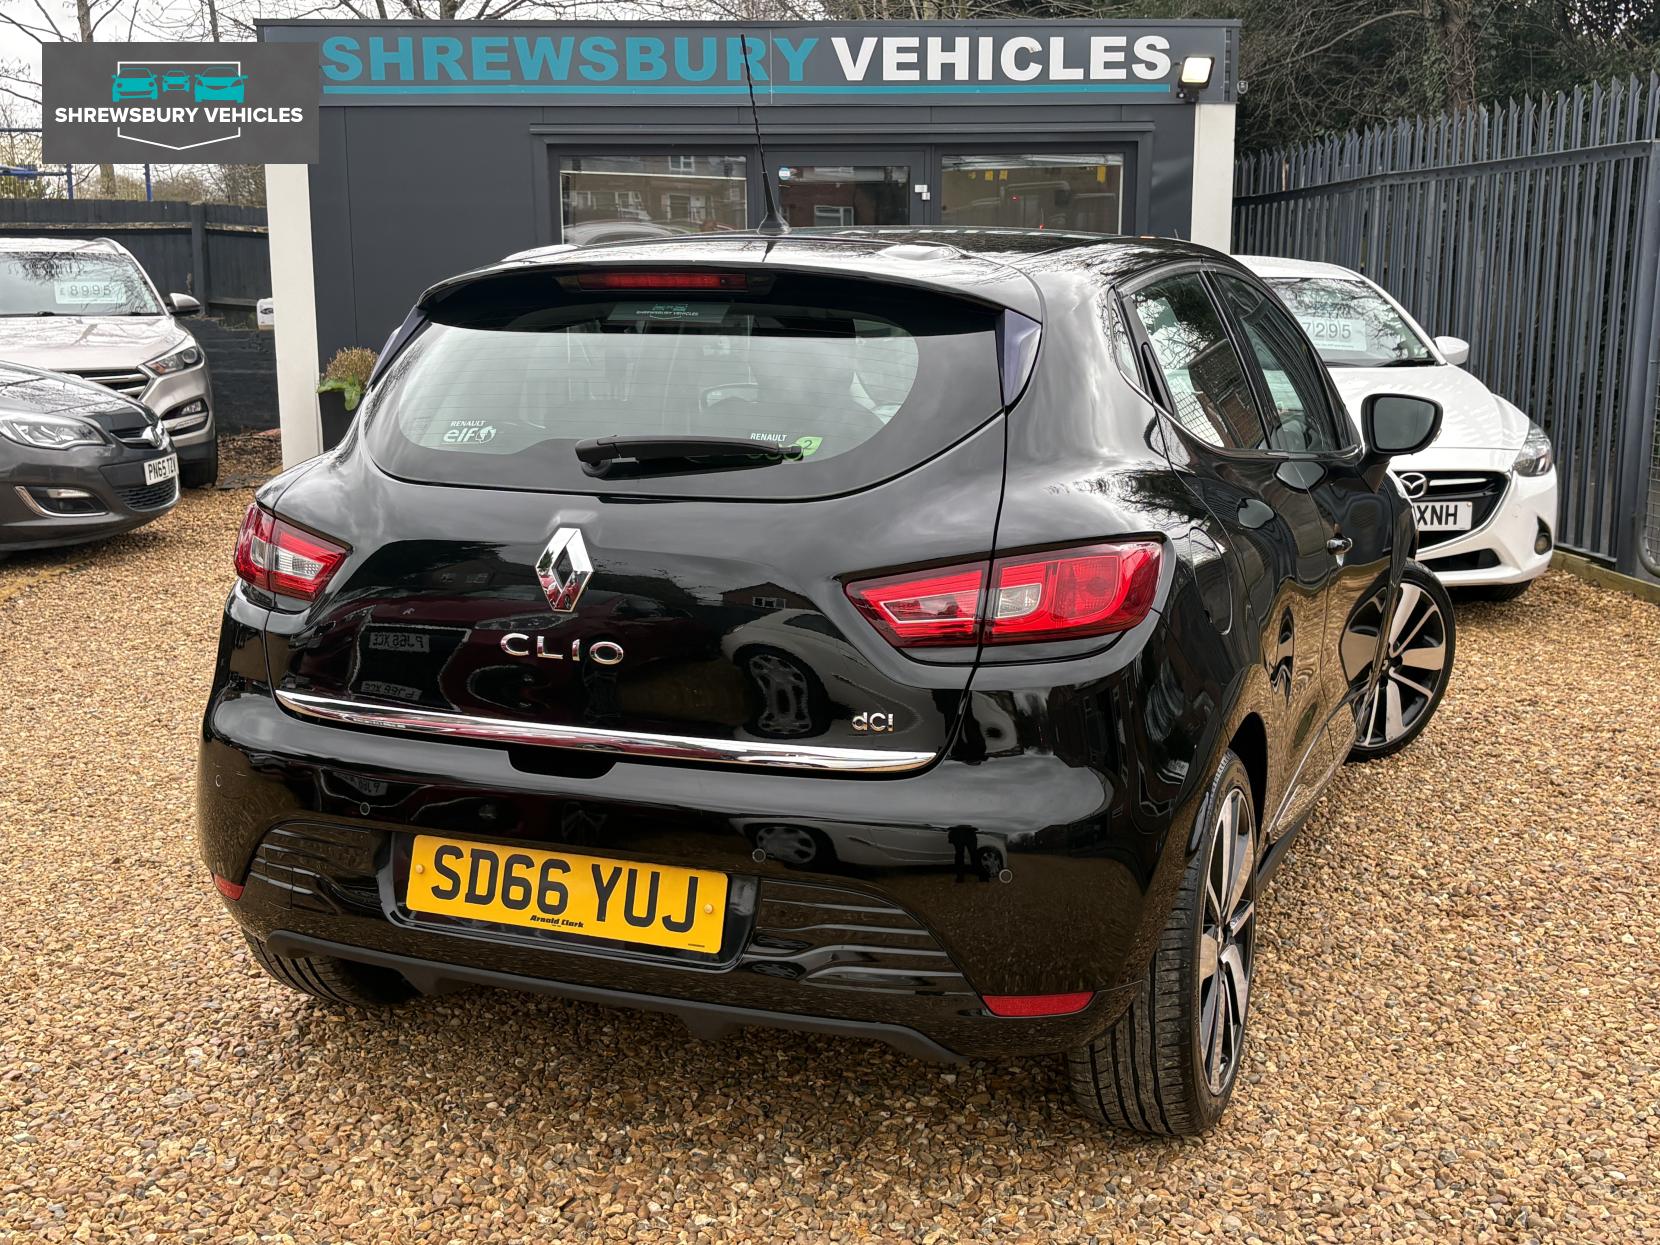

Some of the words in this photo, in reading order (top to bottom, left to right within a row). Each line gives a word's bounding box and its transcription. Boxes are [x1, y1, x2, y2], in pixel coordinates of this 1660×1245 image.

[322, 35, 819, 82] SHREWSBURY
[831, 34, 1172, 82] VEHICLES
[443, 427, 480, 442] elf
[750, 432, 787, 442] RENAULT
[1416, 504, 1458, 526] XNH
[500, 632, 624, 665] CLIO
[431, 844, 572, 915] SD66
[591, 863, 699, 933] YUJ
[530, 915, 560, 925] Arnold
[561, 919, 584, 928] Clark
